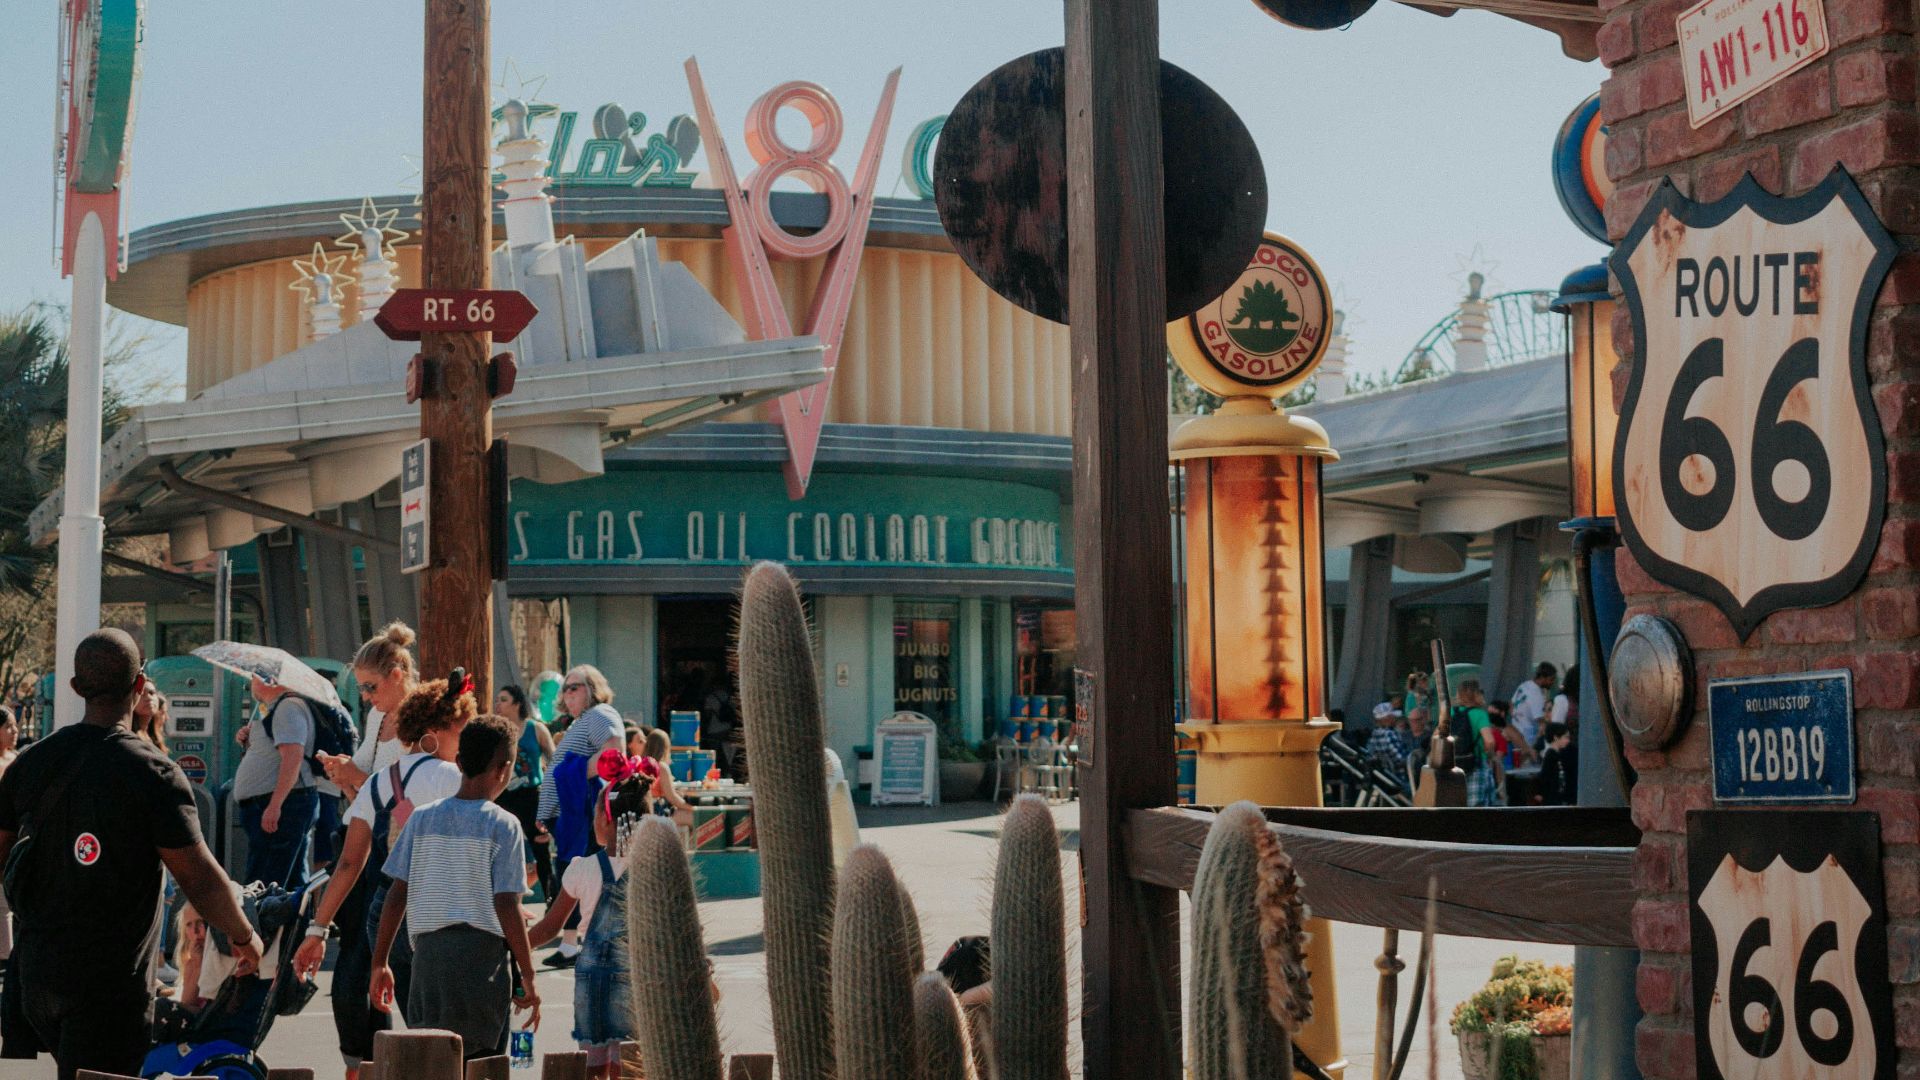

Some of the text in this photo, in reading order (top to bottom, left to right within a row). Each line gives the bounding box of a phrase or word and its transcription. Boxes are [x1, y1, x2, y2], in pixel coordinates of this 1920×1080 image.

[1699, 0, 1809, 103] AW1-116
[423, 298, 496, 323] RT. 66
[1674, 251, 1819, 318] ROUTE
[1203, 320, 1319, 376] GASOLINE
[1658, 337, 1831, 541] 66
[567, 510, 643, 561] GAS
[687, 510, 750, 561] OIL
[787, 511, 948, 564] COOLANT
[899, 642, 950, 656] JUMBO
[913, 664, 939, 679] BIG
[1746, 695, 1811, 712] ROLLINGSTOP
[1736, 725, 1825, 782] 12BB19
[1729, 917, 1854, 1066] 66
